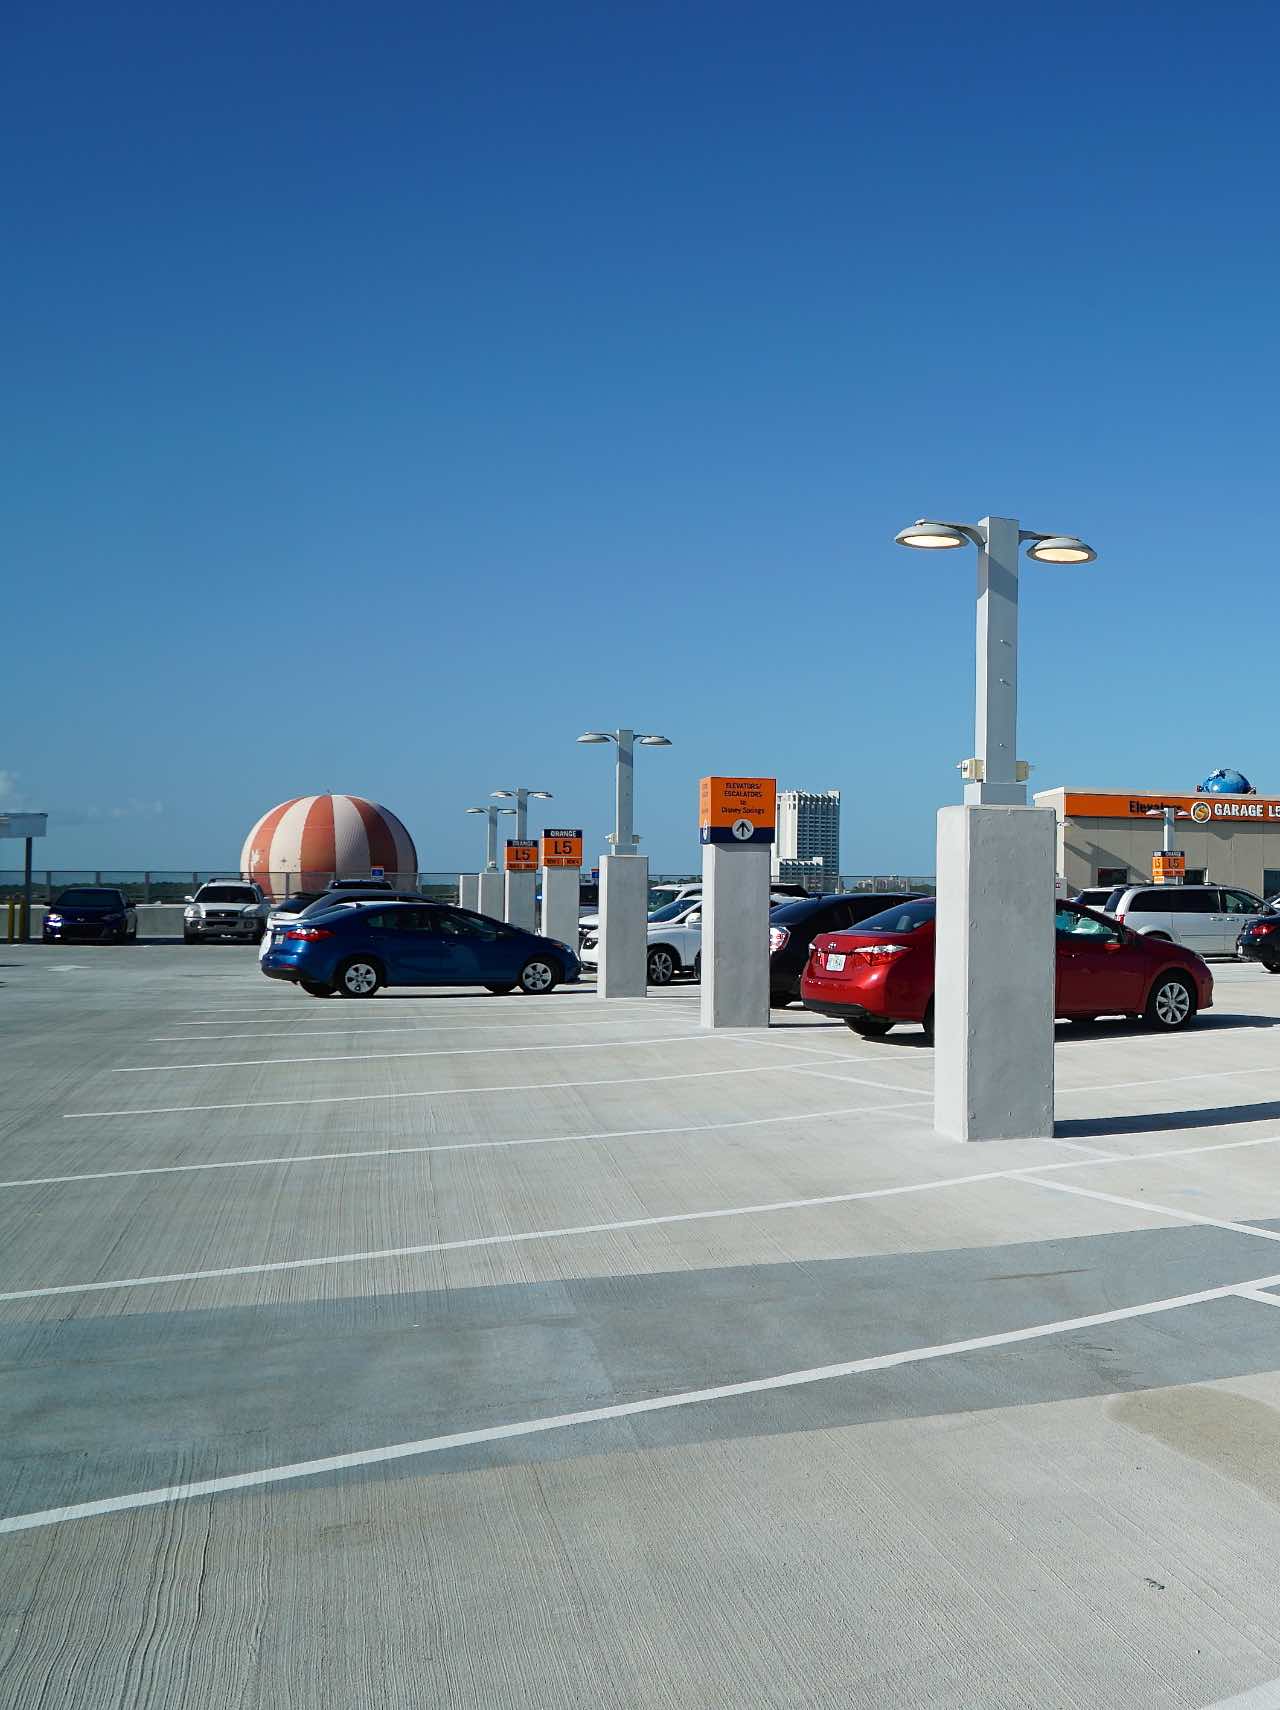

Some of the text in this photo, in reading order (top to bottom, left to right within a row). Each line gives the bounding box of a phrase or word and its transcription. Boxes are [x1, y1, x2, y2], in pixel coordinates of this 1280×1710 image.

[1214, 803, 1264, 817] GARAGE
[515, 848, 530, 860] L5
[554, 841, 572, 855] L5
